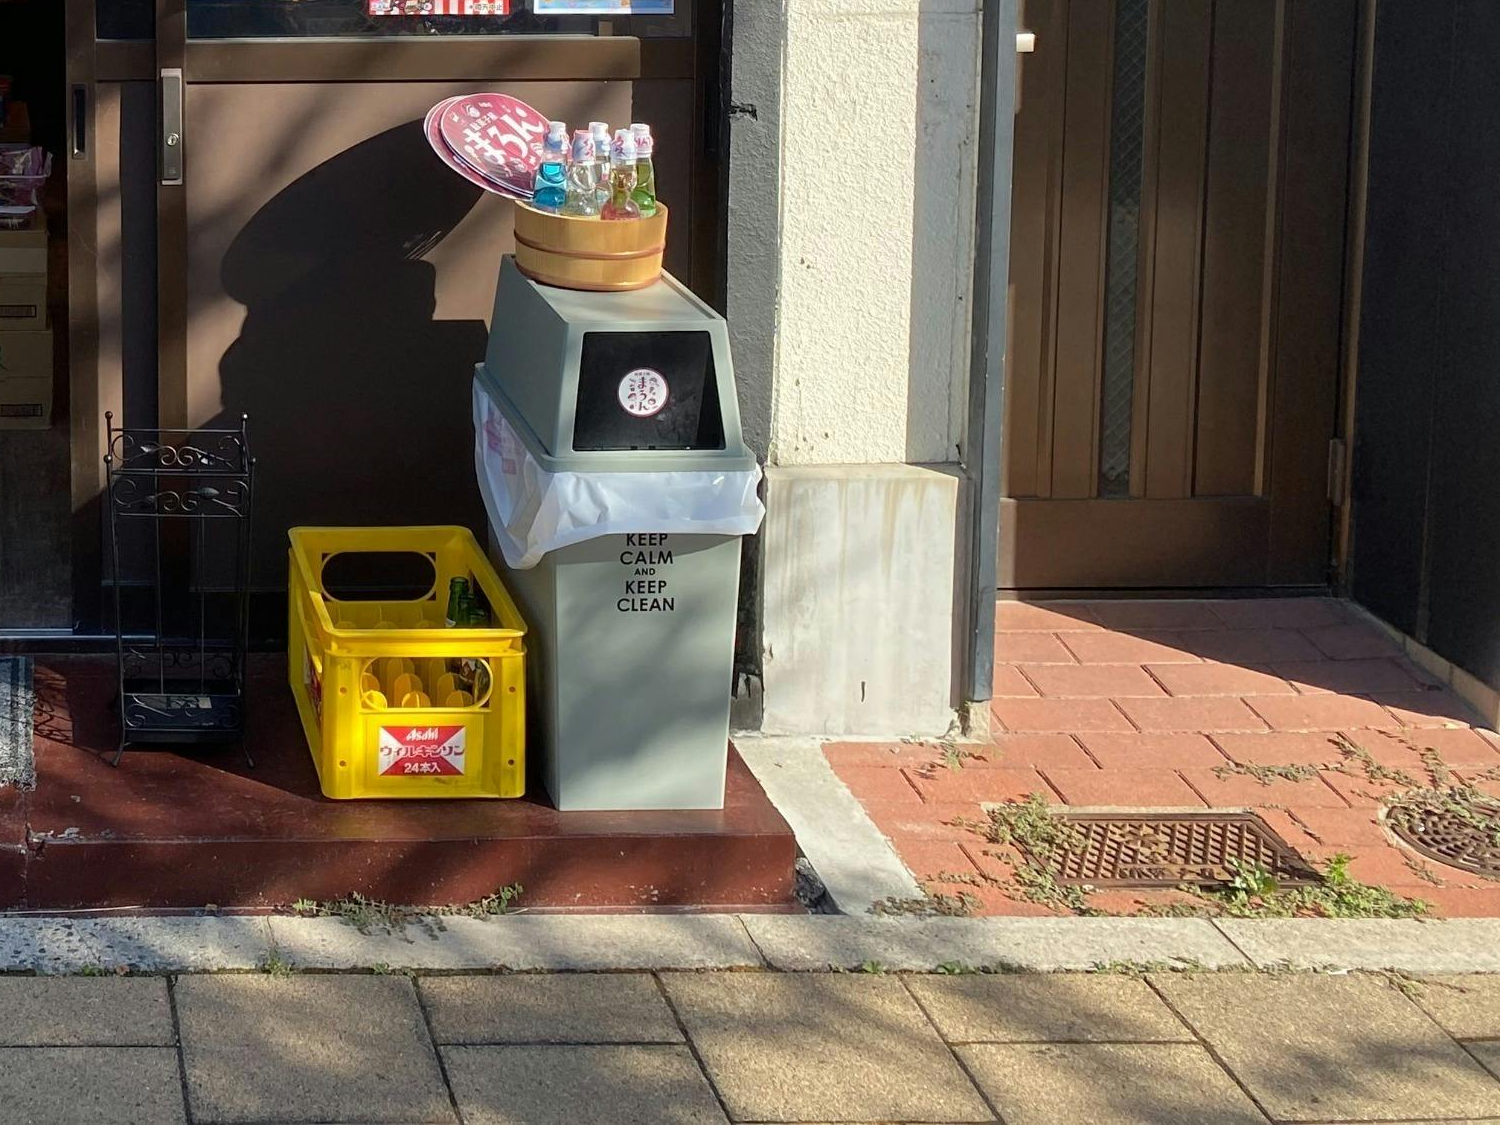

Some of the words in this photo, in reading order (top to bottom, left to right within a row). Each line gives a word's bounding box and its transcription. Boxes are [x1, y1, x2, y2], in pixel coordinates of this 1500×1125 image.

[462, 113, 545, 165] まろん
[626, 533, 668, 546] KEEP
[620, 550, 673, 565] CALM
[634, 567, 656, 576] AND
[625, 580, 667, 594] KEEP
[617, 597, 675, 612] CLEAN
[405, 727, 439, 742] Asahi
[379, 744, 465, 758] ウィルキンソン
[404, 762, 441, 773] 24本入
